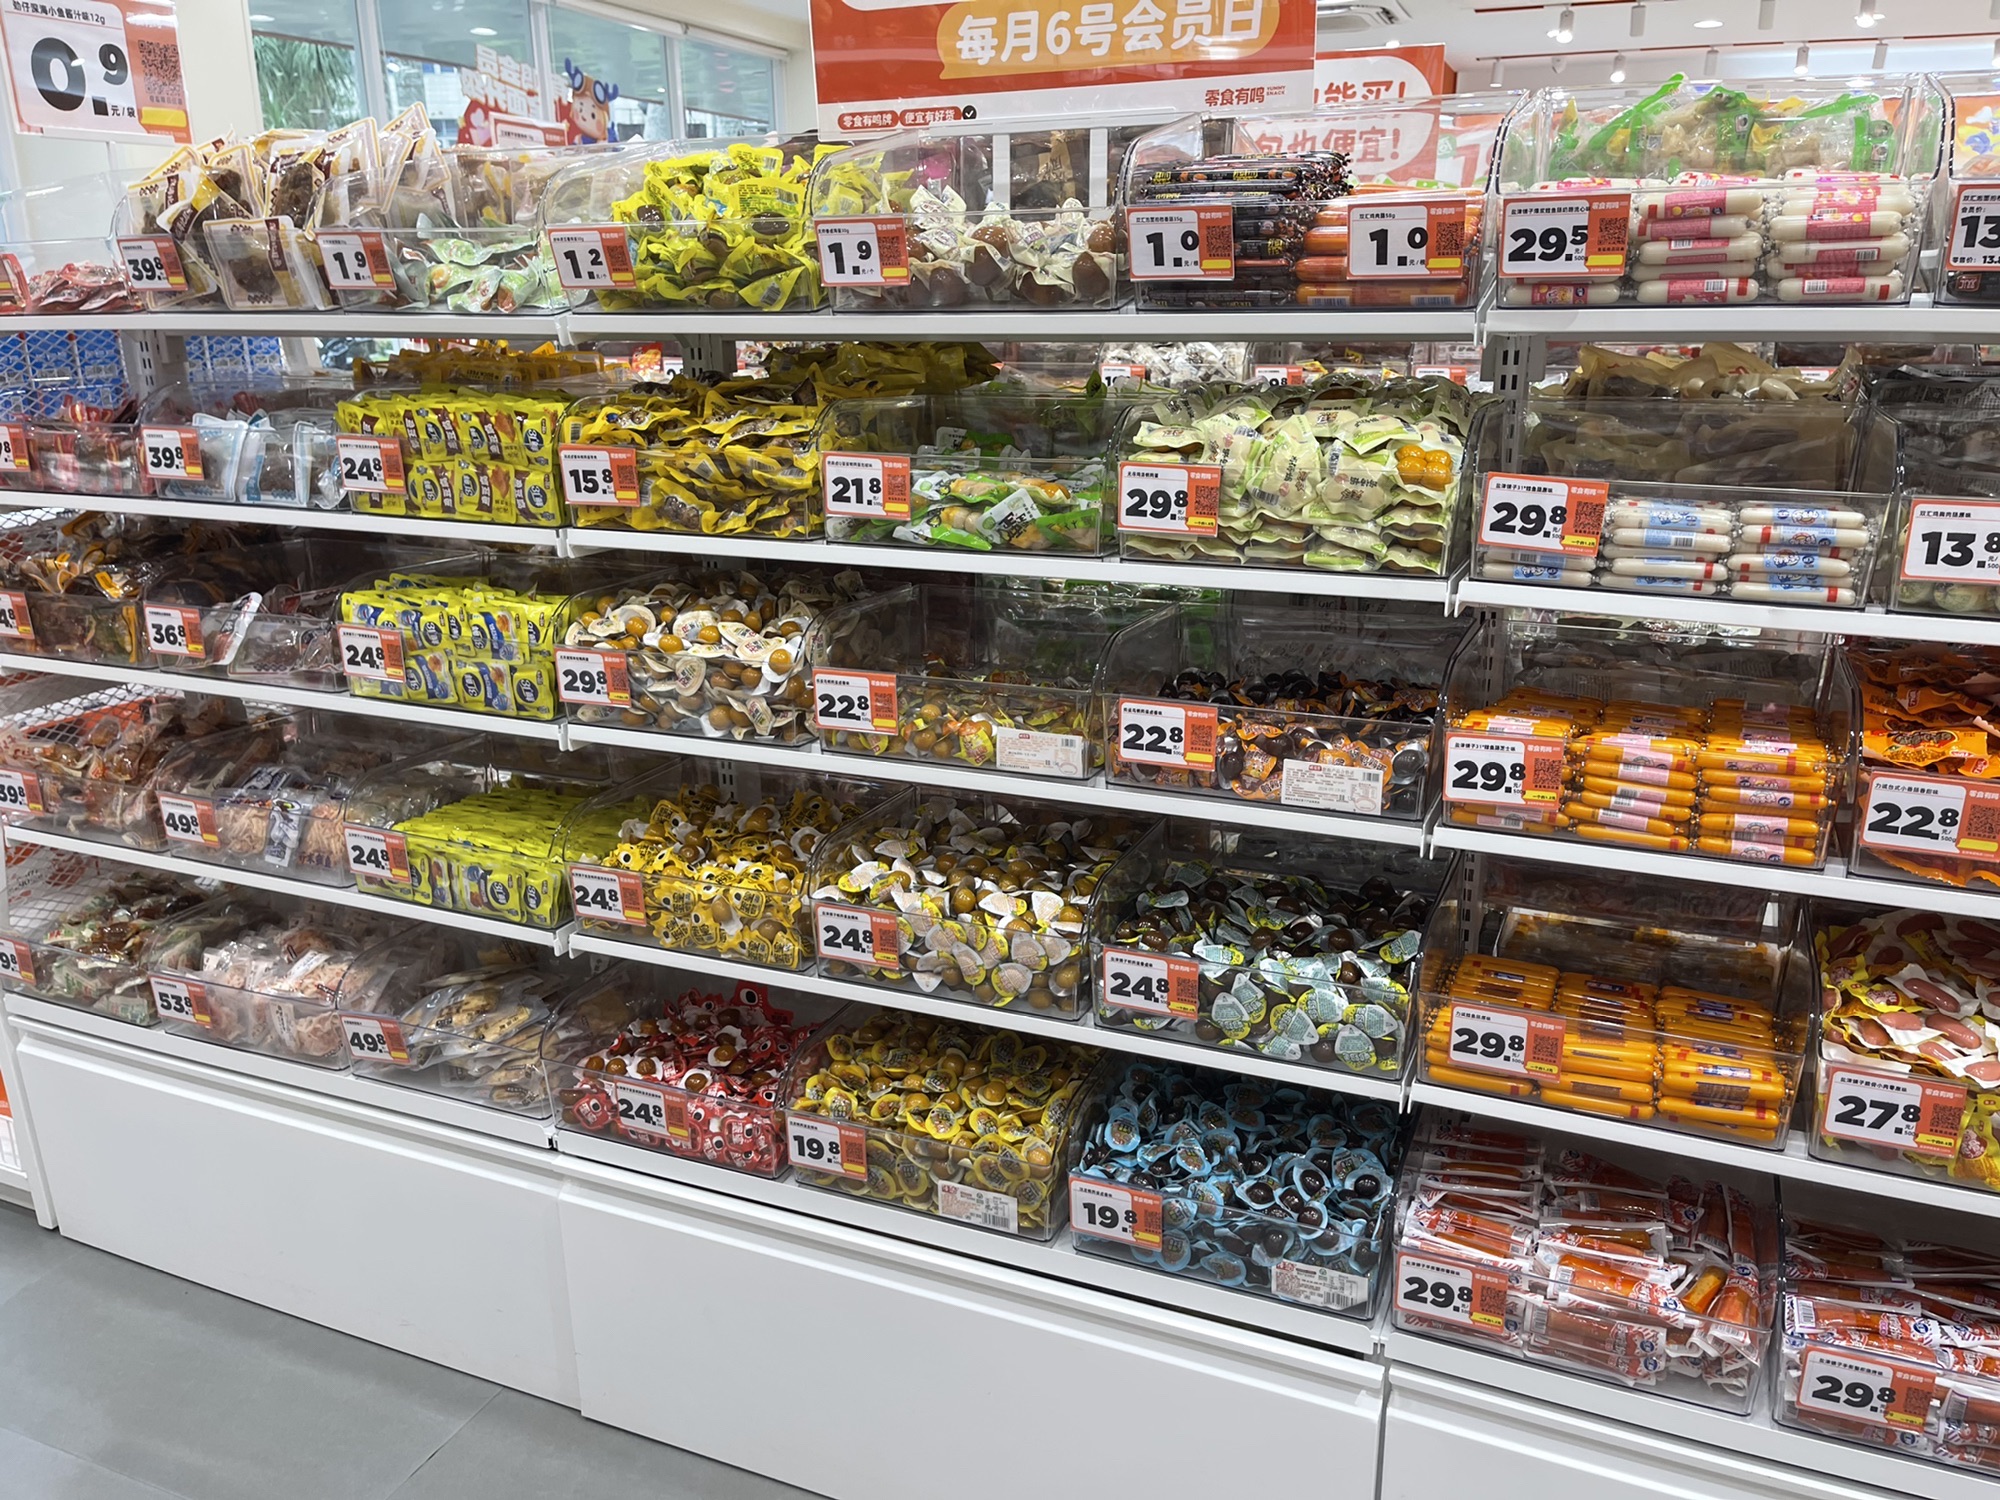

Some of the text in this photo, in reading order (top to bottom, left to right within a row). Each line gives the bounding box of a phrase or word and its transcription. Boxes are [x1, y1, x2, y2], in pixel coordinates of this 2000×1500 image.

[956, 0, 1263, 66] 每月6号会员日
[1205, 87, 1265, 107] 零食有鸣
[828, 240, 873, 275] 1.9
[1146, 230, 1200, 267] 1.0
[1369, 227, 1428, 266] 1.0
[1508, 225, 1588, 262] 29.5
[127, 257, 165, 281] 39.8
[332, 252, 367, 280] 1.9
[563, 249, 604, 279] 1.2
[148, 446, 184, 470] 39.8
[342, 457, 382, 482] 24.8
[569, 469, 614, 495] 15.8
[832, 476, 881, 506] 21.8
[1125, 488, 1188, 521] 29.8
[1489, 502, 1567, 539] 29.8
[151, 623, 186, 647] 36.8
[345, 644, 385, 670] 24.8
[562, 669, 608, 695] 29.8
[818, 693, 869, 722] 22.8
[1122, 723, 1183, 755] 22.8
[1452, 760, 1526, 794] 29.8
[165, 812, 198, 835] 49.8
[1868, 802, 1959, 840] 22.8
[351, 845, 390, 871] 24.8
[575, 885, 619, 911] 24.8
[823, 925, 874, 954] 24.8
[1110, 972, 1170, 1004] 24.8
[158, 991, 192, 1015] 53.8
[350, 1032, 386, 1053] 49.8
[1453, 1027, 1524, 1062] 29.8
[618, 1098, 663, 1126] 24.8
[1834, 1095, 1920, 1135] 27.8
[793, 1135, 840, 1163] 19.8
[1083, 1203, 1138, 1232] 19.8
[1403, 1276, 1473, 1312] 29.8
[1811, 1375, 1896, 1412] 29.8
